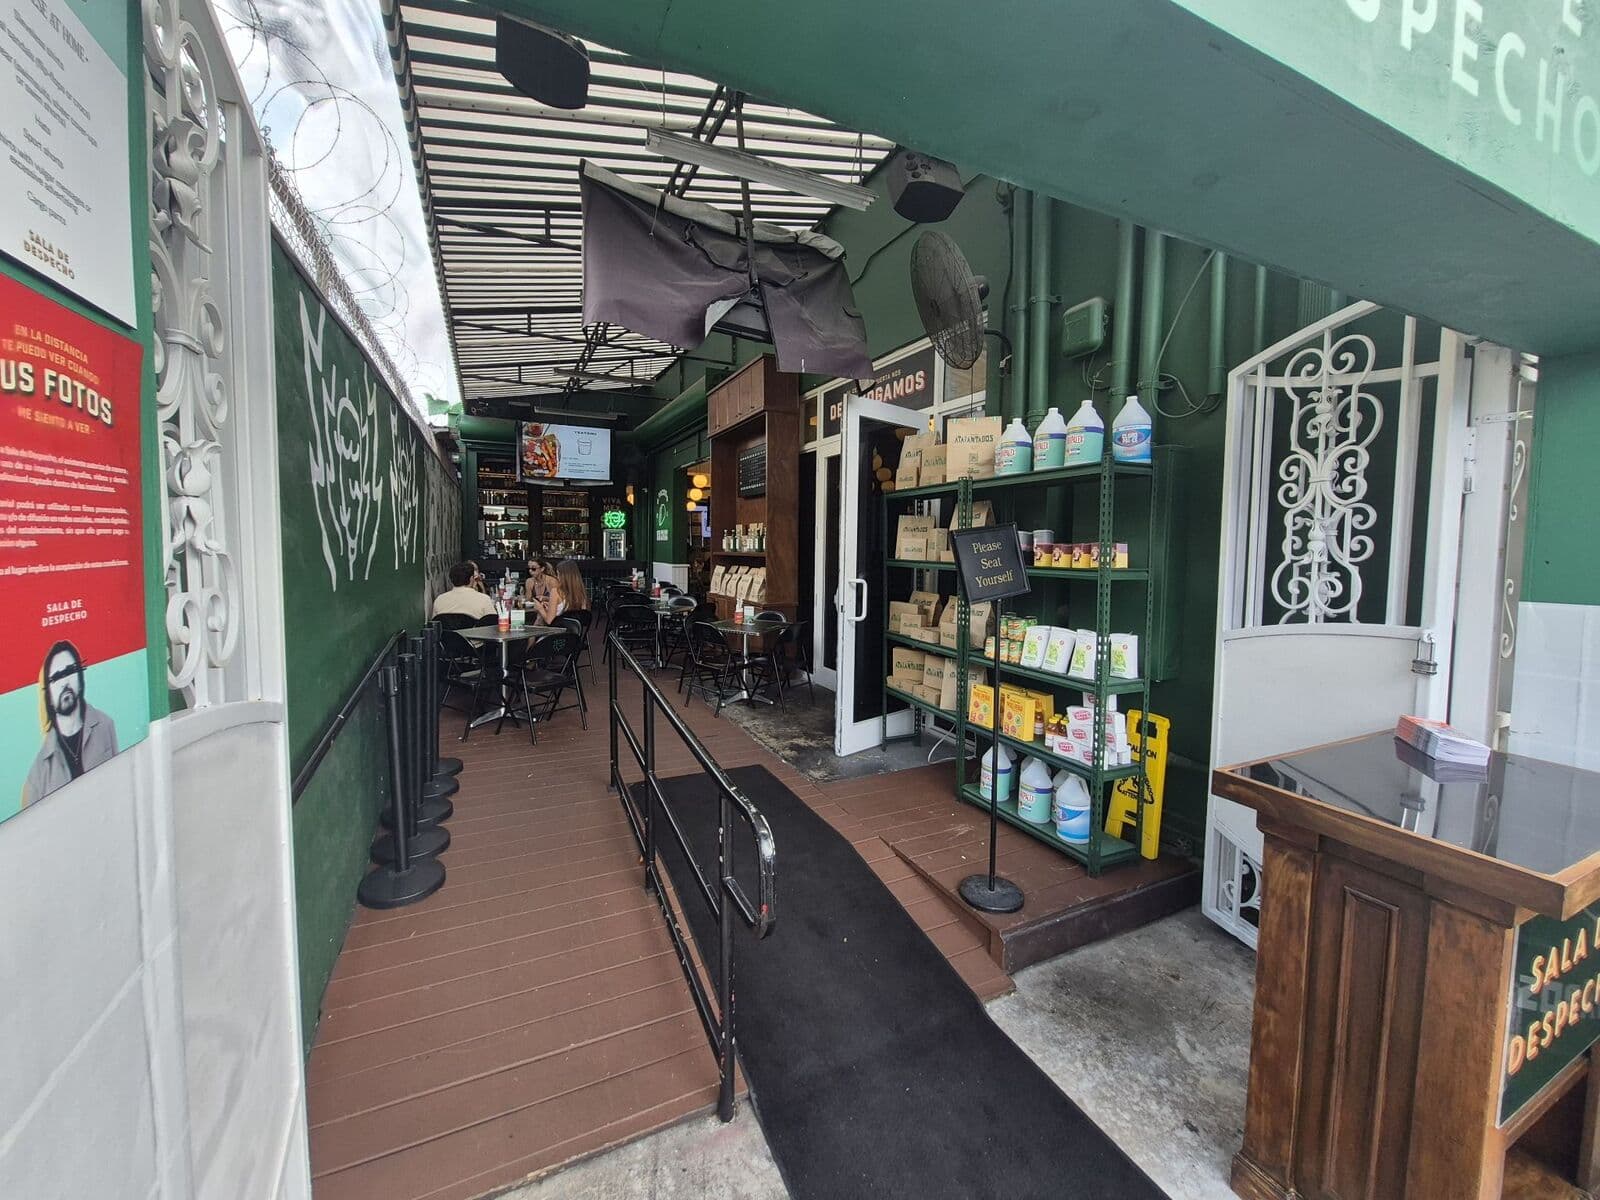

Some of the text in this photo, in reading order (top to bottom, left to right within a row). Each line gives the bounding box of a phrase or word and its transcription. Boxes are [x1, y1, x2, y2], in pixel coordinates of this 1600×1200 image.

[1347, 0, 1600, 176] PECHO
[24, 240, 75, 279] DESPECHO
[29, 229, 70, 264] SALA DE
[15, 324, 88, 364] EN LA DISTANCIA
[16, 341, 47, 358] PUEDO
[48, 350, 66, 367] VER
[67, 360, 100, 385] CUANDO
[44, 368, 113, 425] FOTOS
[67, 420, 74, 430] A
[74, 421, 91, 434] VER
[972, 541, 1002, 554] Please
[980, 557, 1002, 569] Seat
[975, 570, 1013, 588] Yourself
[42, 610, 87, 627] DESPECHO
[46, 599, 83, 613] SALA DE
[1530, 928, 1588, 994] SALA
